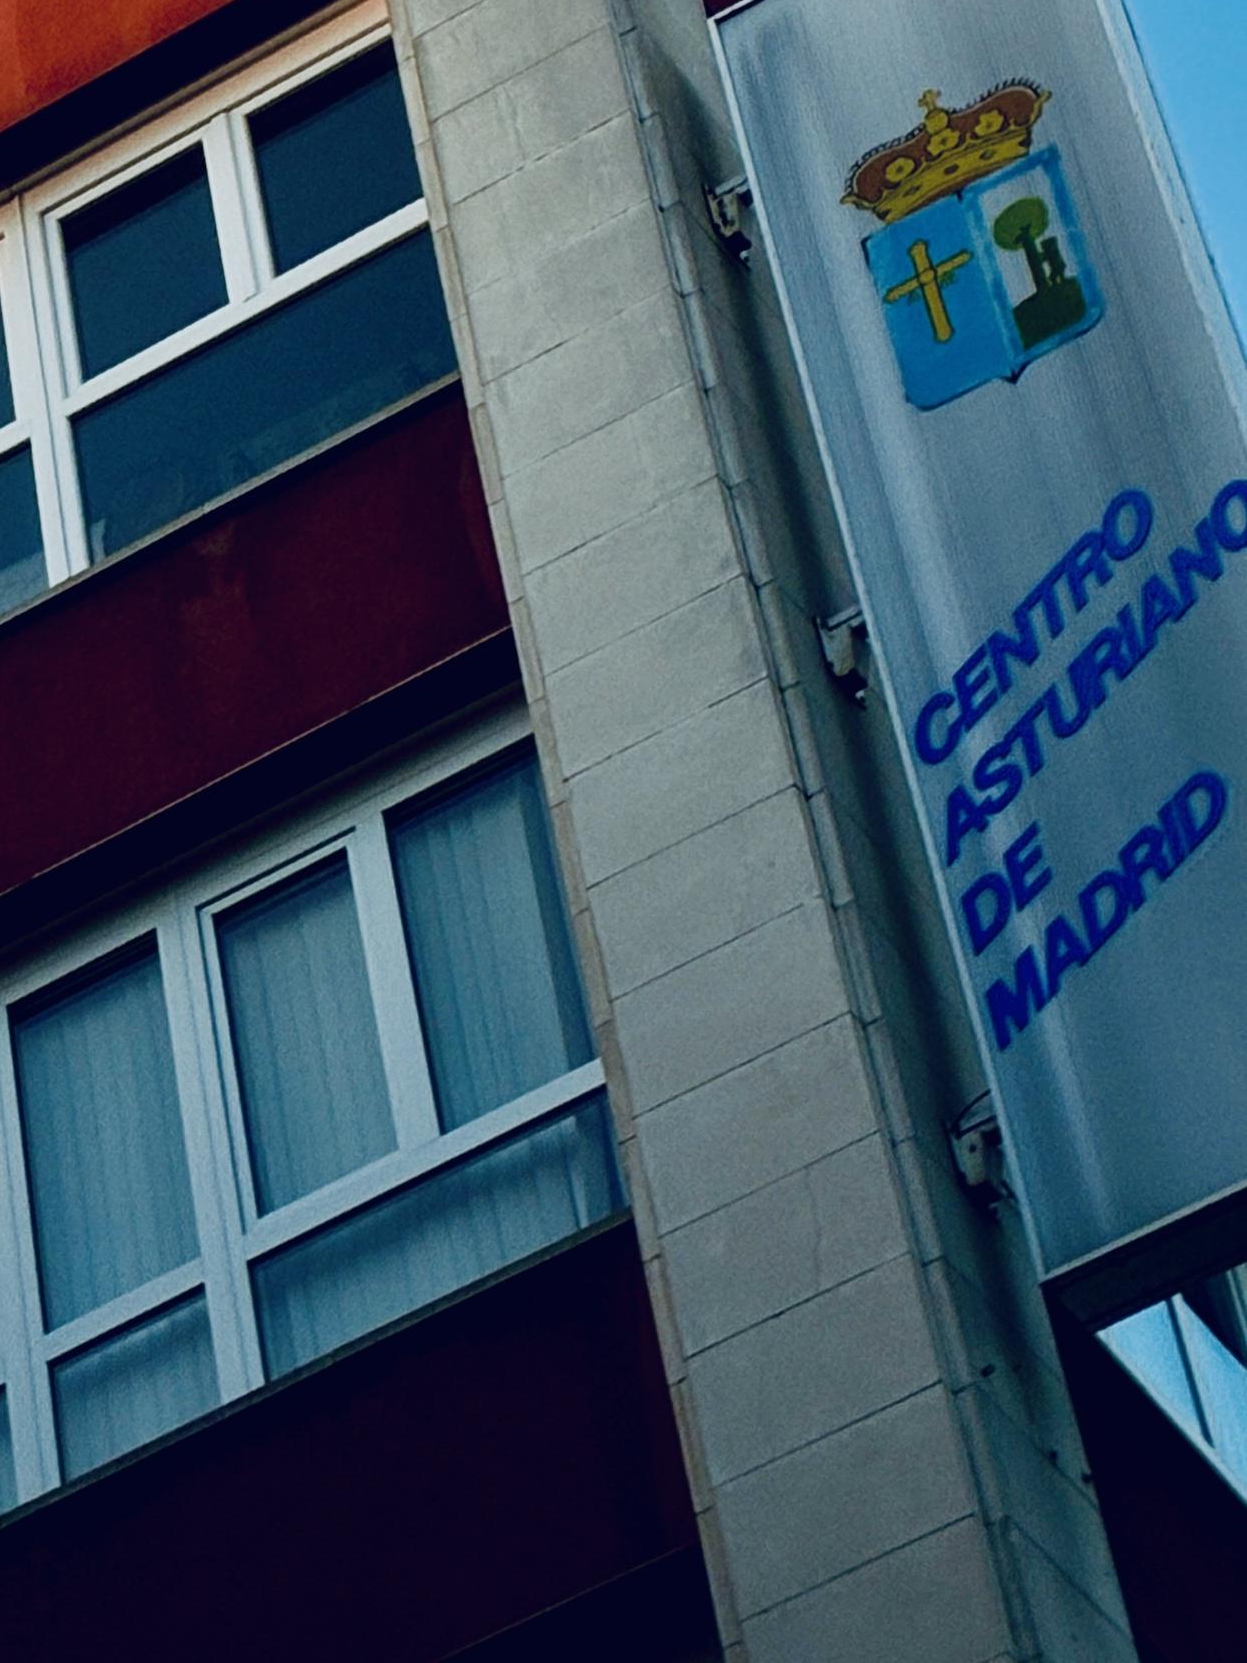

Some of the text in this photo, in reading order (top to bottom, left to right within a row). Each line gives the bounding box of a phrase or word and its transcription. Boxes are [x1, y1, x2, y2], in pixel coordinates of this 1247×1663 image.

[912, 488, 1153, 766] CENTRO
[945, 479, 1247, 865] ASTURIANO
[959, 822, 1053, 956] DE
[984, 770, 1228, 1051] MADRID
